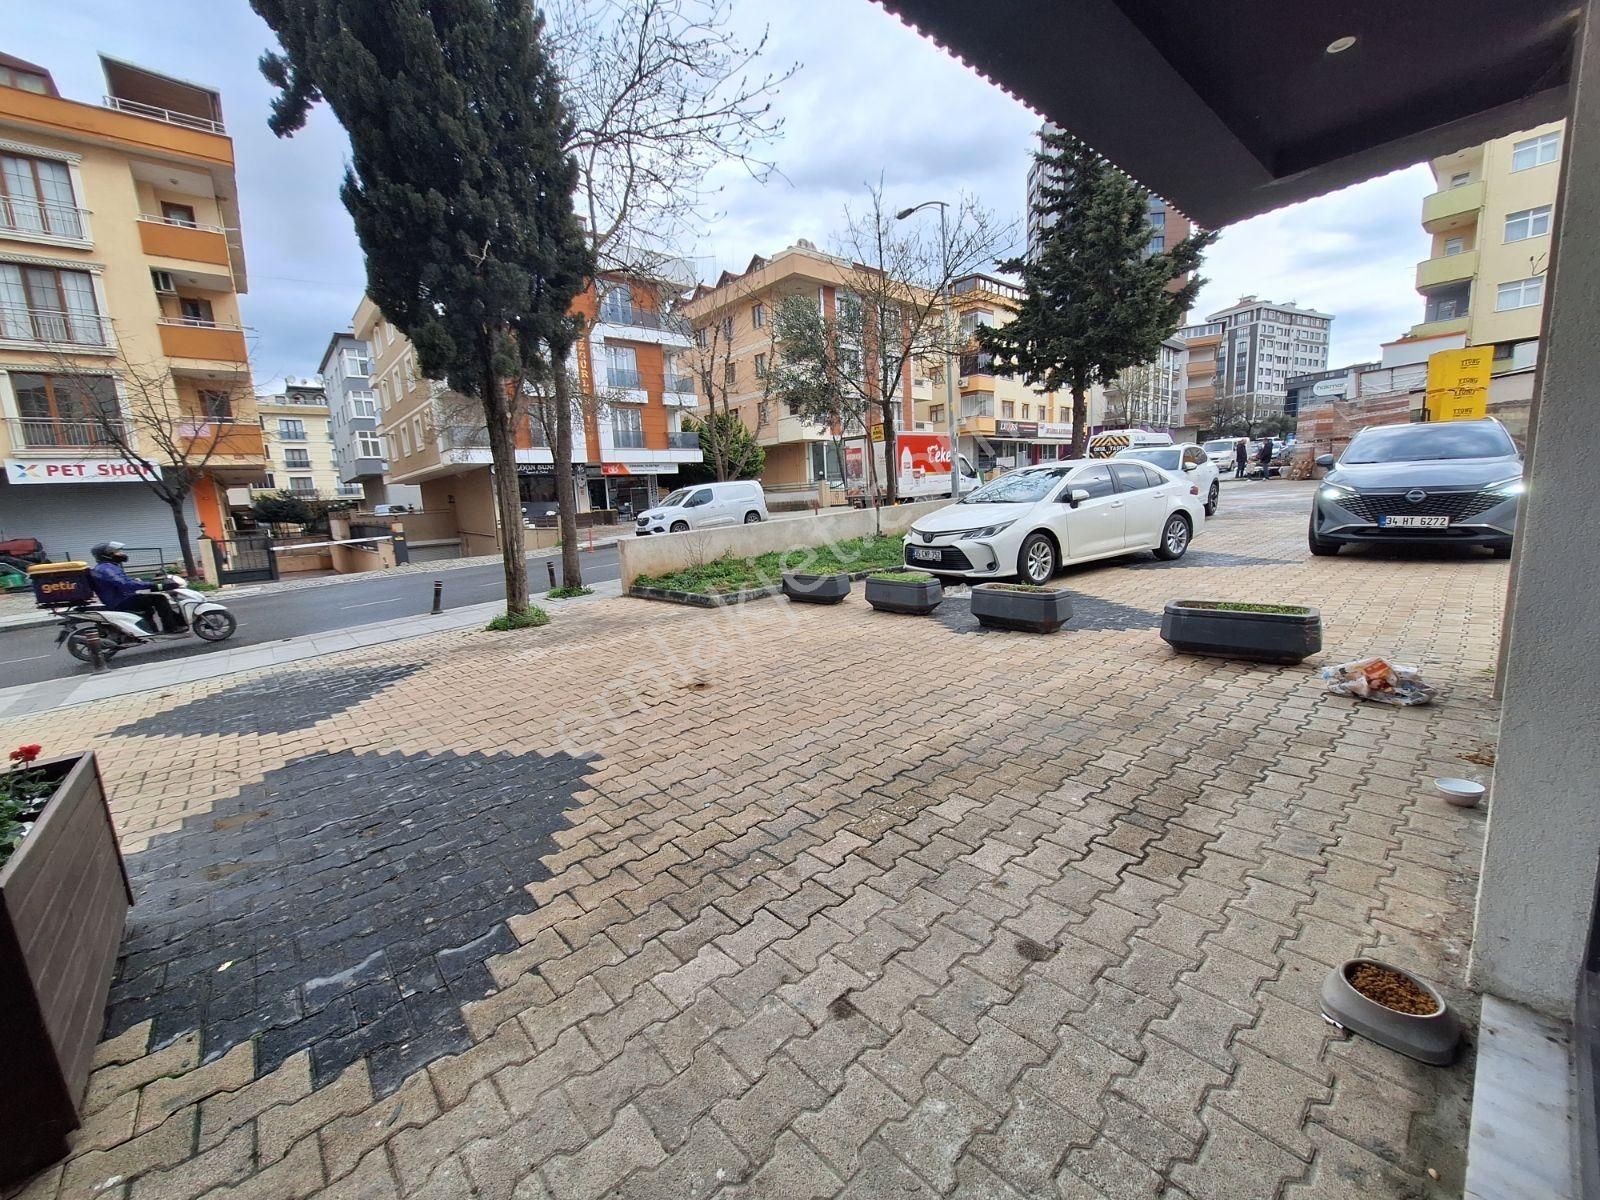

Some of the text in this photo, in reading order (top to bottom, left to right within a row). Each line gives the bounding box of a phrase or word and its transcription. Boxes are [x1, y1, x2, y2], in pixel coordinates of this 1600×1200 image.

[927, 444, 956, 463] Eke
[46, 464, 85, 477] PET
[1386, 517, 1447, 526] 34 HT 6272
[41, 581, 77, 594] getir
